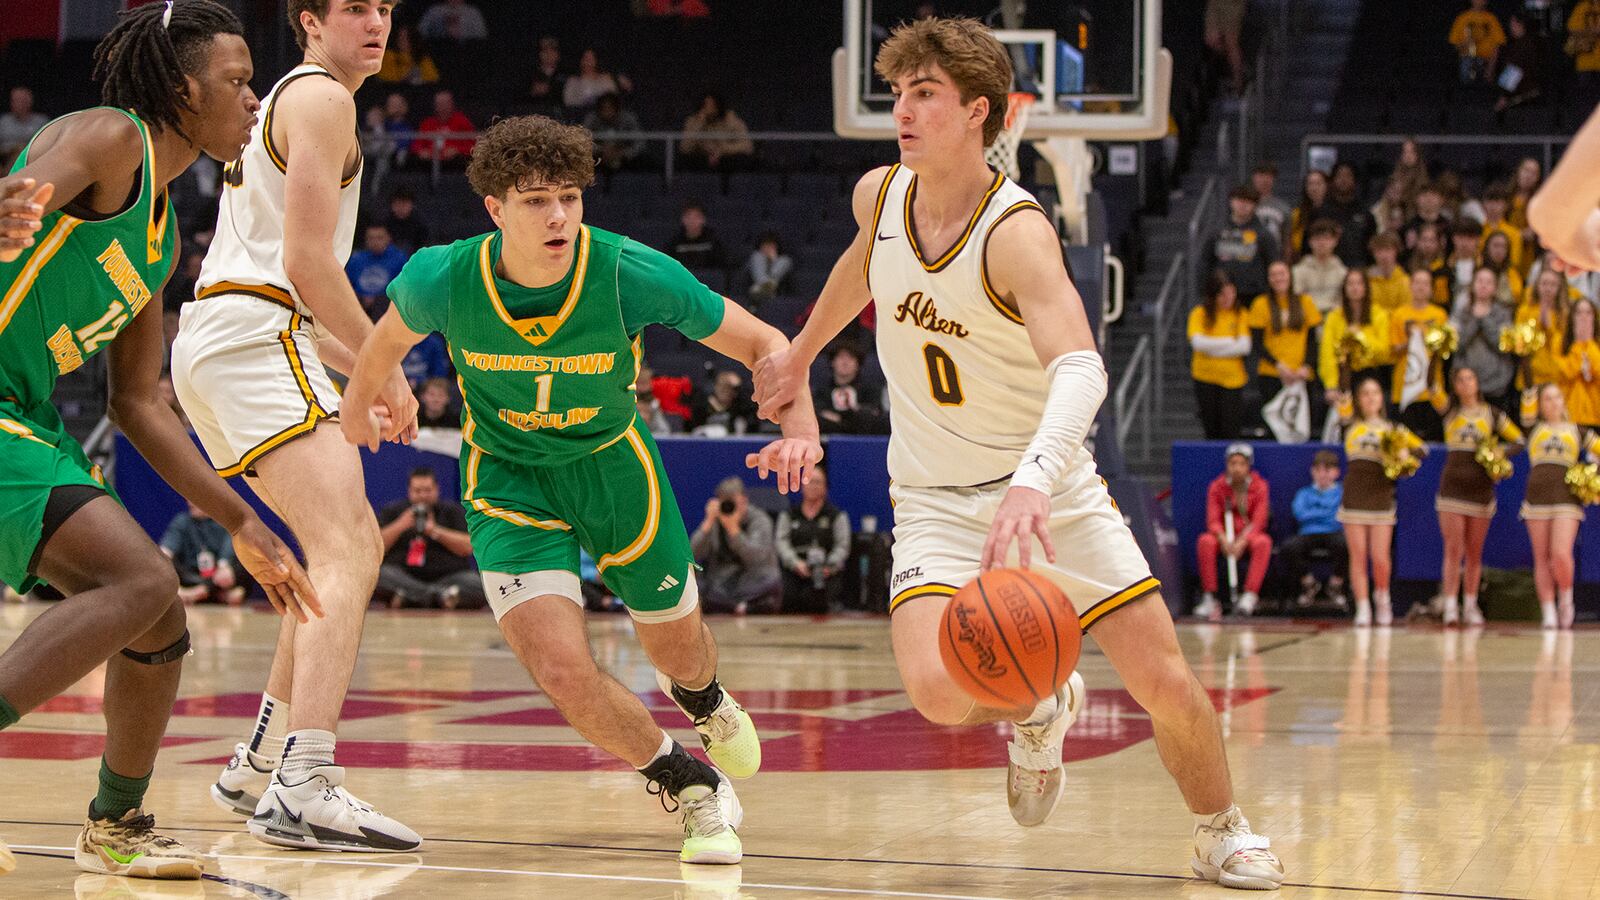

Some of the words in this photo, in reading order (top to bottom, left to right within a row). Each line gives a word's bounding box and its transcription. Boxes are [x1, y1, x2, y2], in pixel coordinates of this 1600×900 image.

[74, 299, 129, 354] 12
[894, 290, 969, 338] Alter
[461, 348, 617, 375] YOUNGSTOWN
[922, 341, 966, 407] 0
[534, 374, 553, 413] 1
[498, 406, 602, 432] URSULINE
